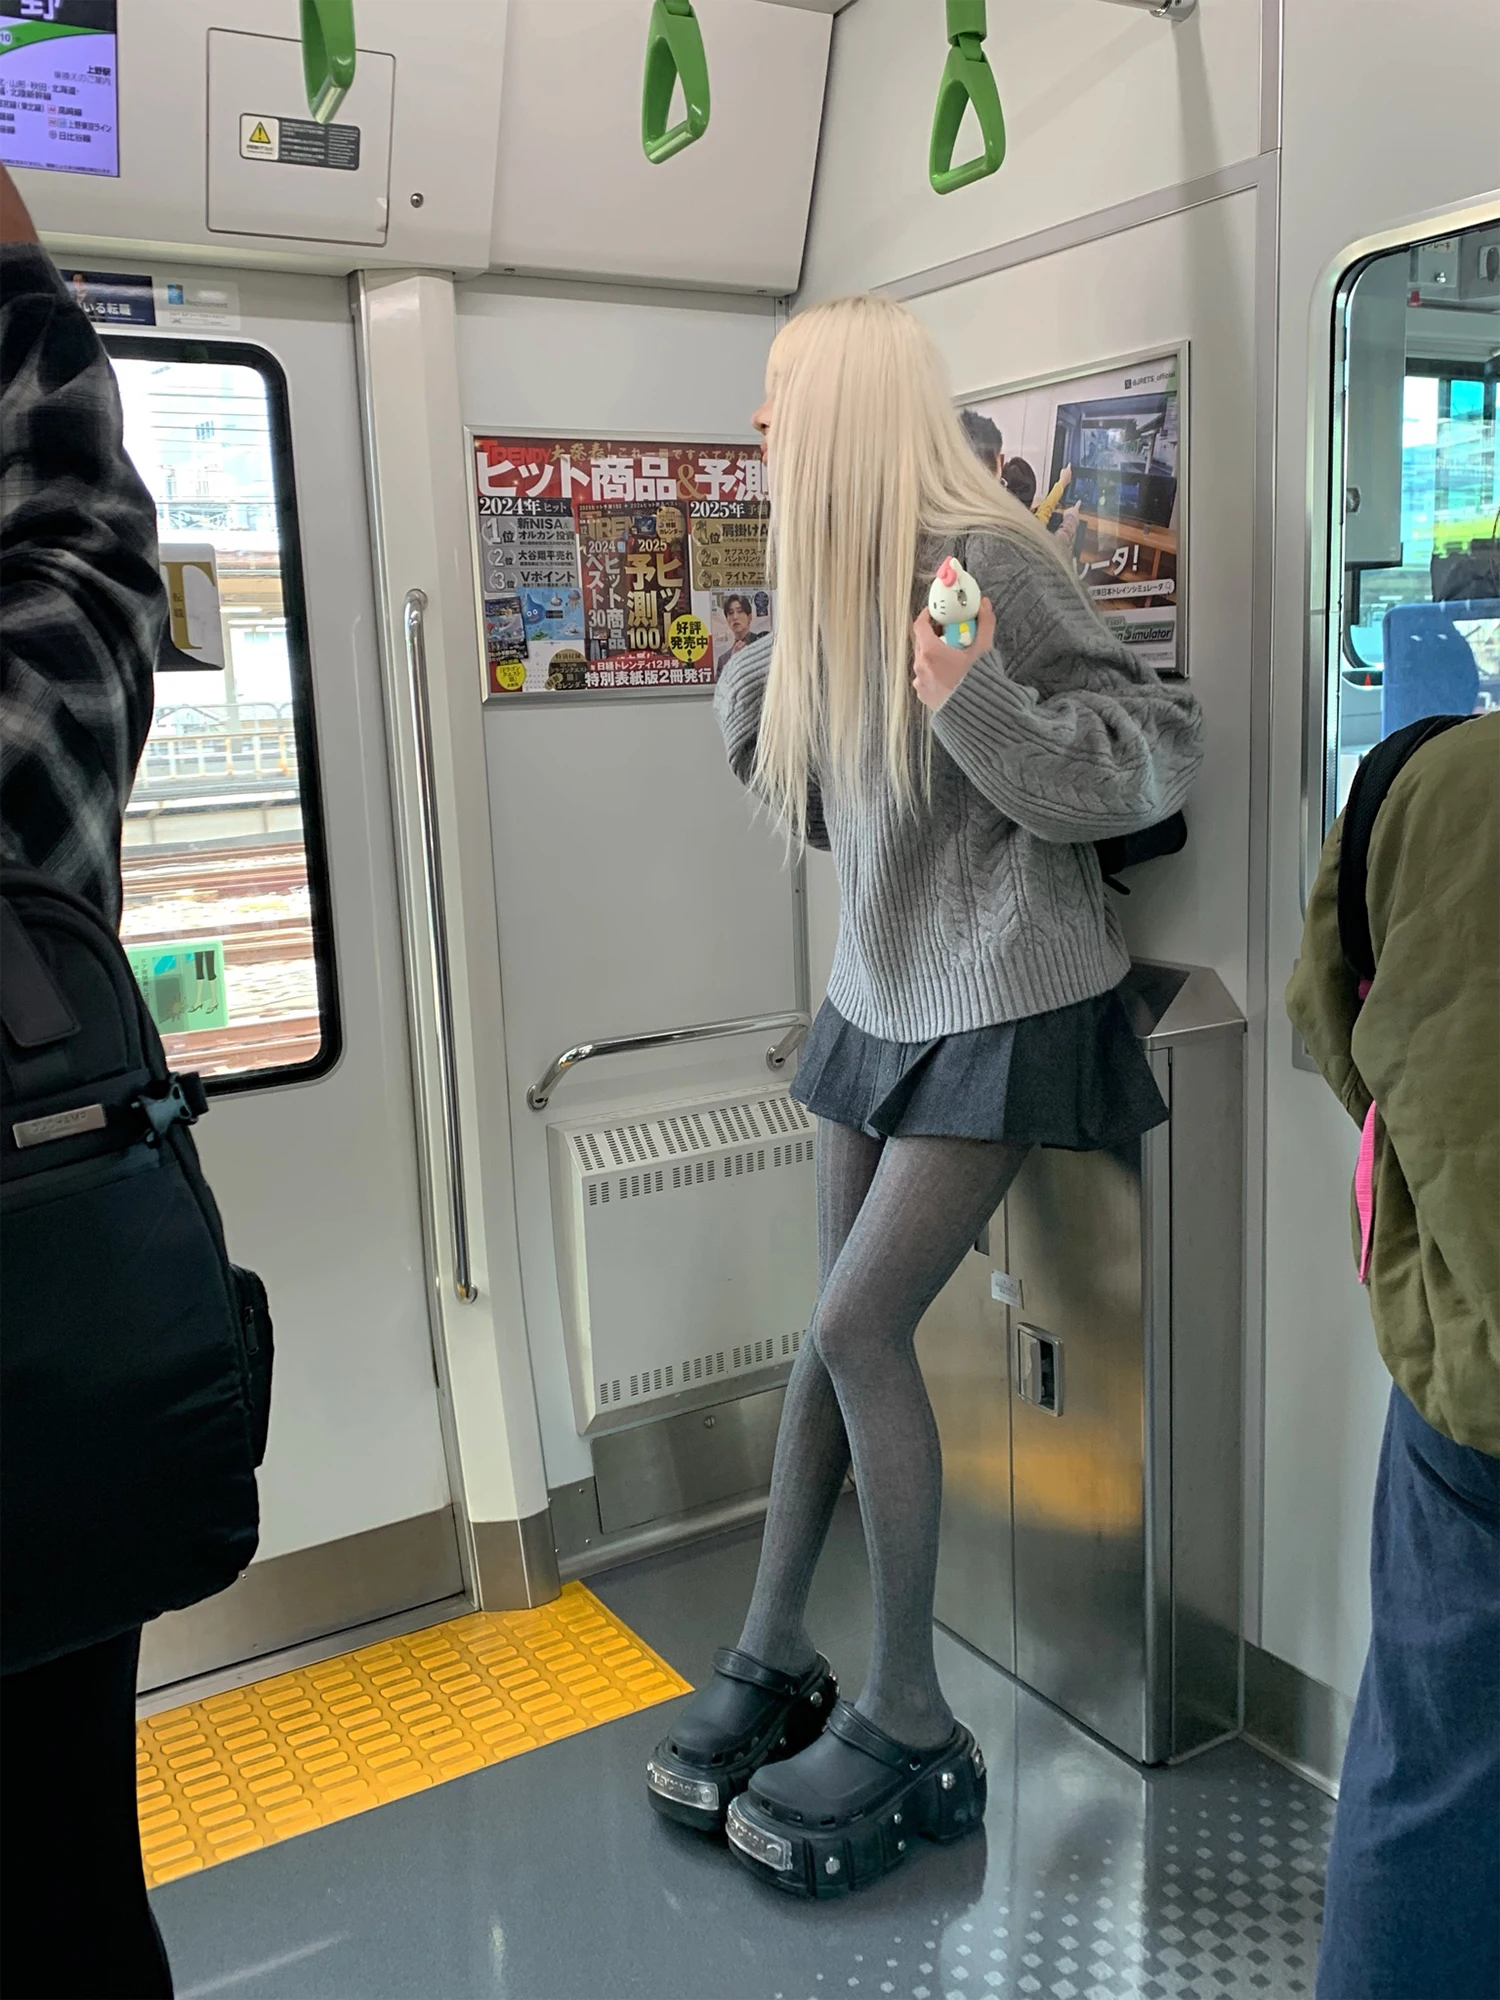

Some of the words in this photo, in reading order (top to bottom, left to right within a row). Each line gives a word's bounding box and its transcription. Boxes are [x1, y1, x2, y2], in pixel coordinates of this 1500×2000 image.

[479, 497, 541, 516] 2024年
[690, 501, 745, 518] 2025年
[588, 540, 616, 554] 2024
[638, 539, 668, 552] 2025
[520, 571, 576, 583] Vポイント
[676, 621, 702, 635] 好評
[670, 634, 708, 650] 発売中
[584, 668, 713, 688] 特別表紙版2冊発行
